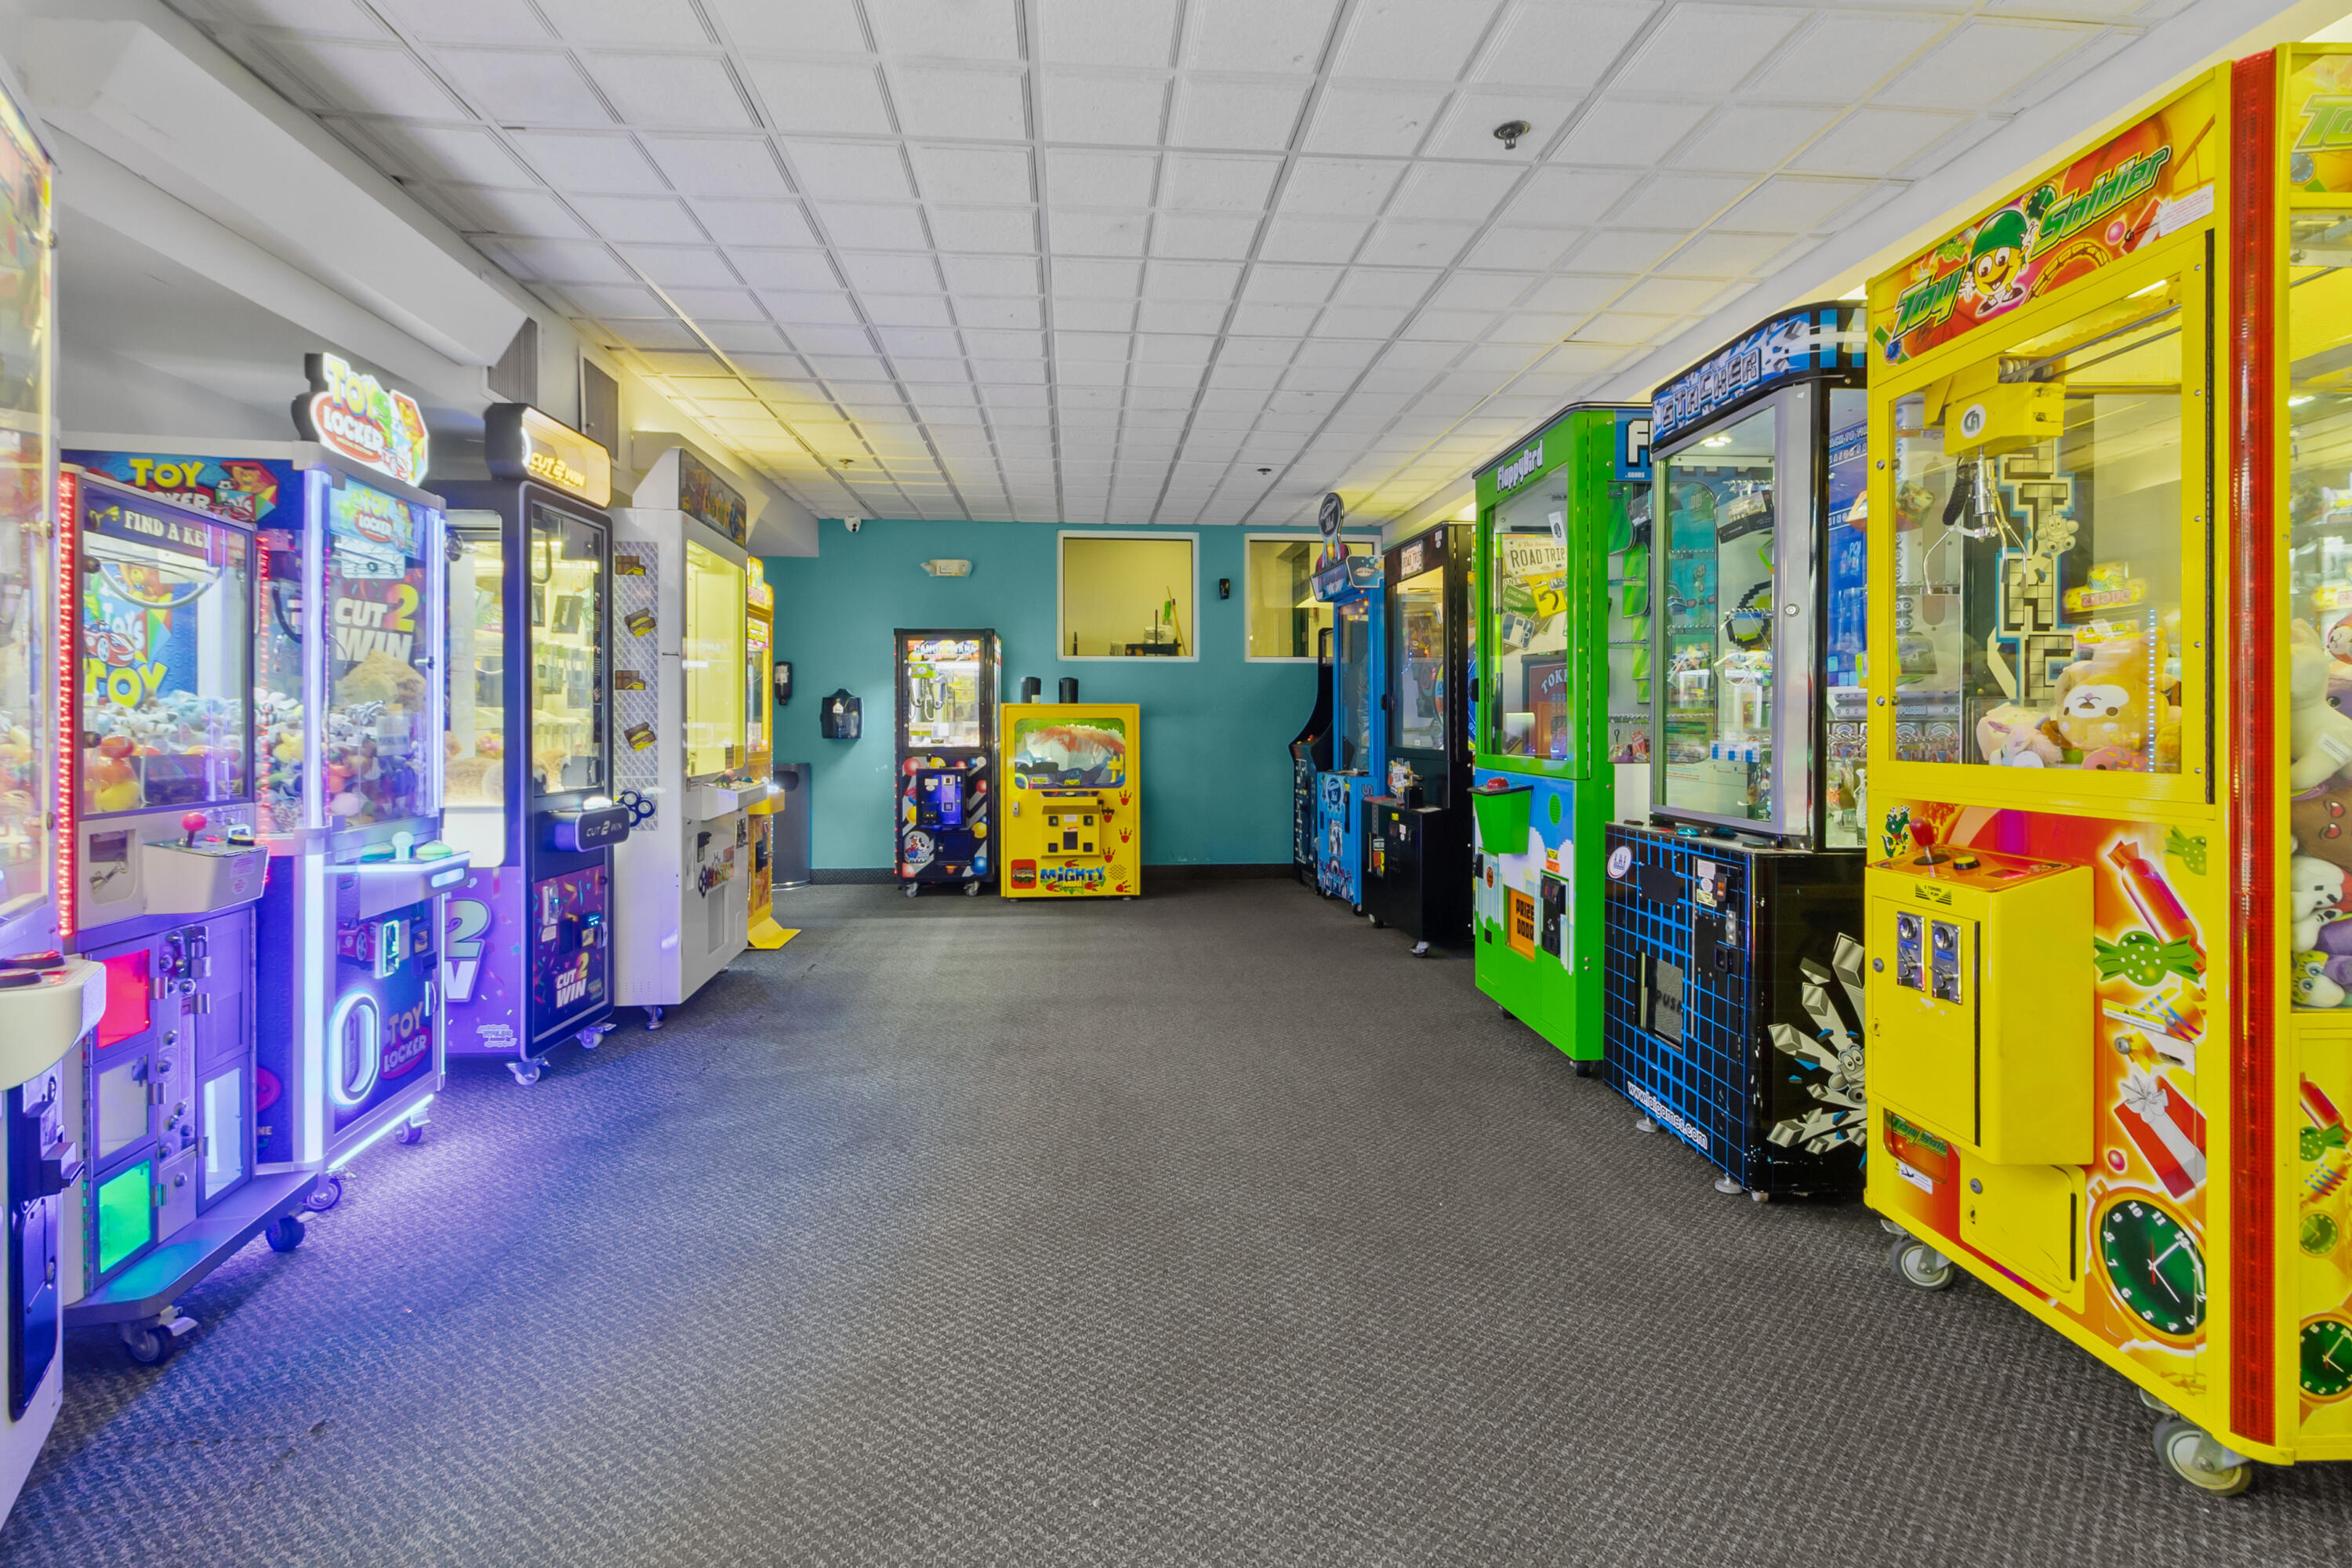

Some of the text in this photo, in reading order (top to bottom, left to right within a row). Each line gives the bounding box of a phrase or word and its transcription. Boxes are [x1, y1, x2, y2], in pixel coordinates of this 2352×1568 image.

[1890, 263, 1966, 343] Toy
[2029, 146, 2172, 263] Soldier
[328, 358, 380, 424] TOY
[1662, 350, 1759, 429] STACKER
[323, 405, 385, 456] LOCKER
[129, 459, 205, 488] TOY
[124, 510, 165, 538] FIND
[166, 522, 180, 542] A
[1510, 547, 1566, 569] ROAD TRIP
[334, 583, 419, 633] CUT 2
[336, 626, 414, 664] WIN
[83, 657, 168, 709] TOY
[601, 820, 611, 836] 2
[1516, 897, 1534, 922] PRIZE
[1517, 918, 1534, 942] DOOR
[556, 968, 577, 989] CUT
[575, 951, 590, 981] 2
[556, 978, 587, 1009] WIN
[1656, 989, 1682, 1014] PUSH
[387, 1001, 424, 1047] TOY
[383, 1034, 427, 1073] LOCKER
[1627, 1080, 1708, 1151] www.laigames.com
[2128, 1201, 2143, 1218] 10
